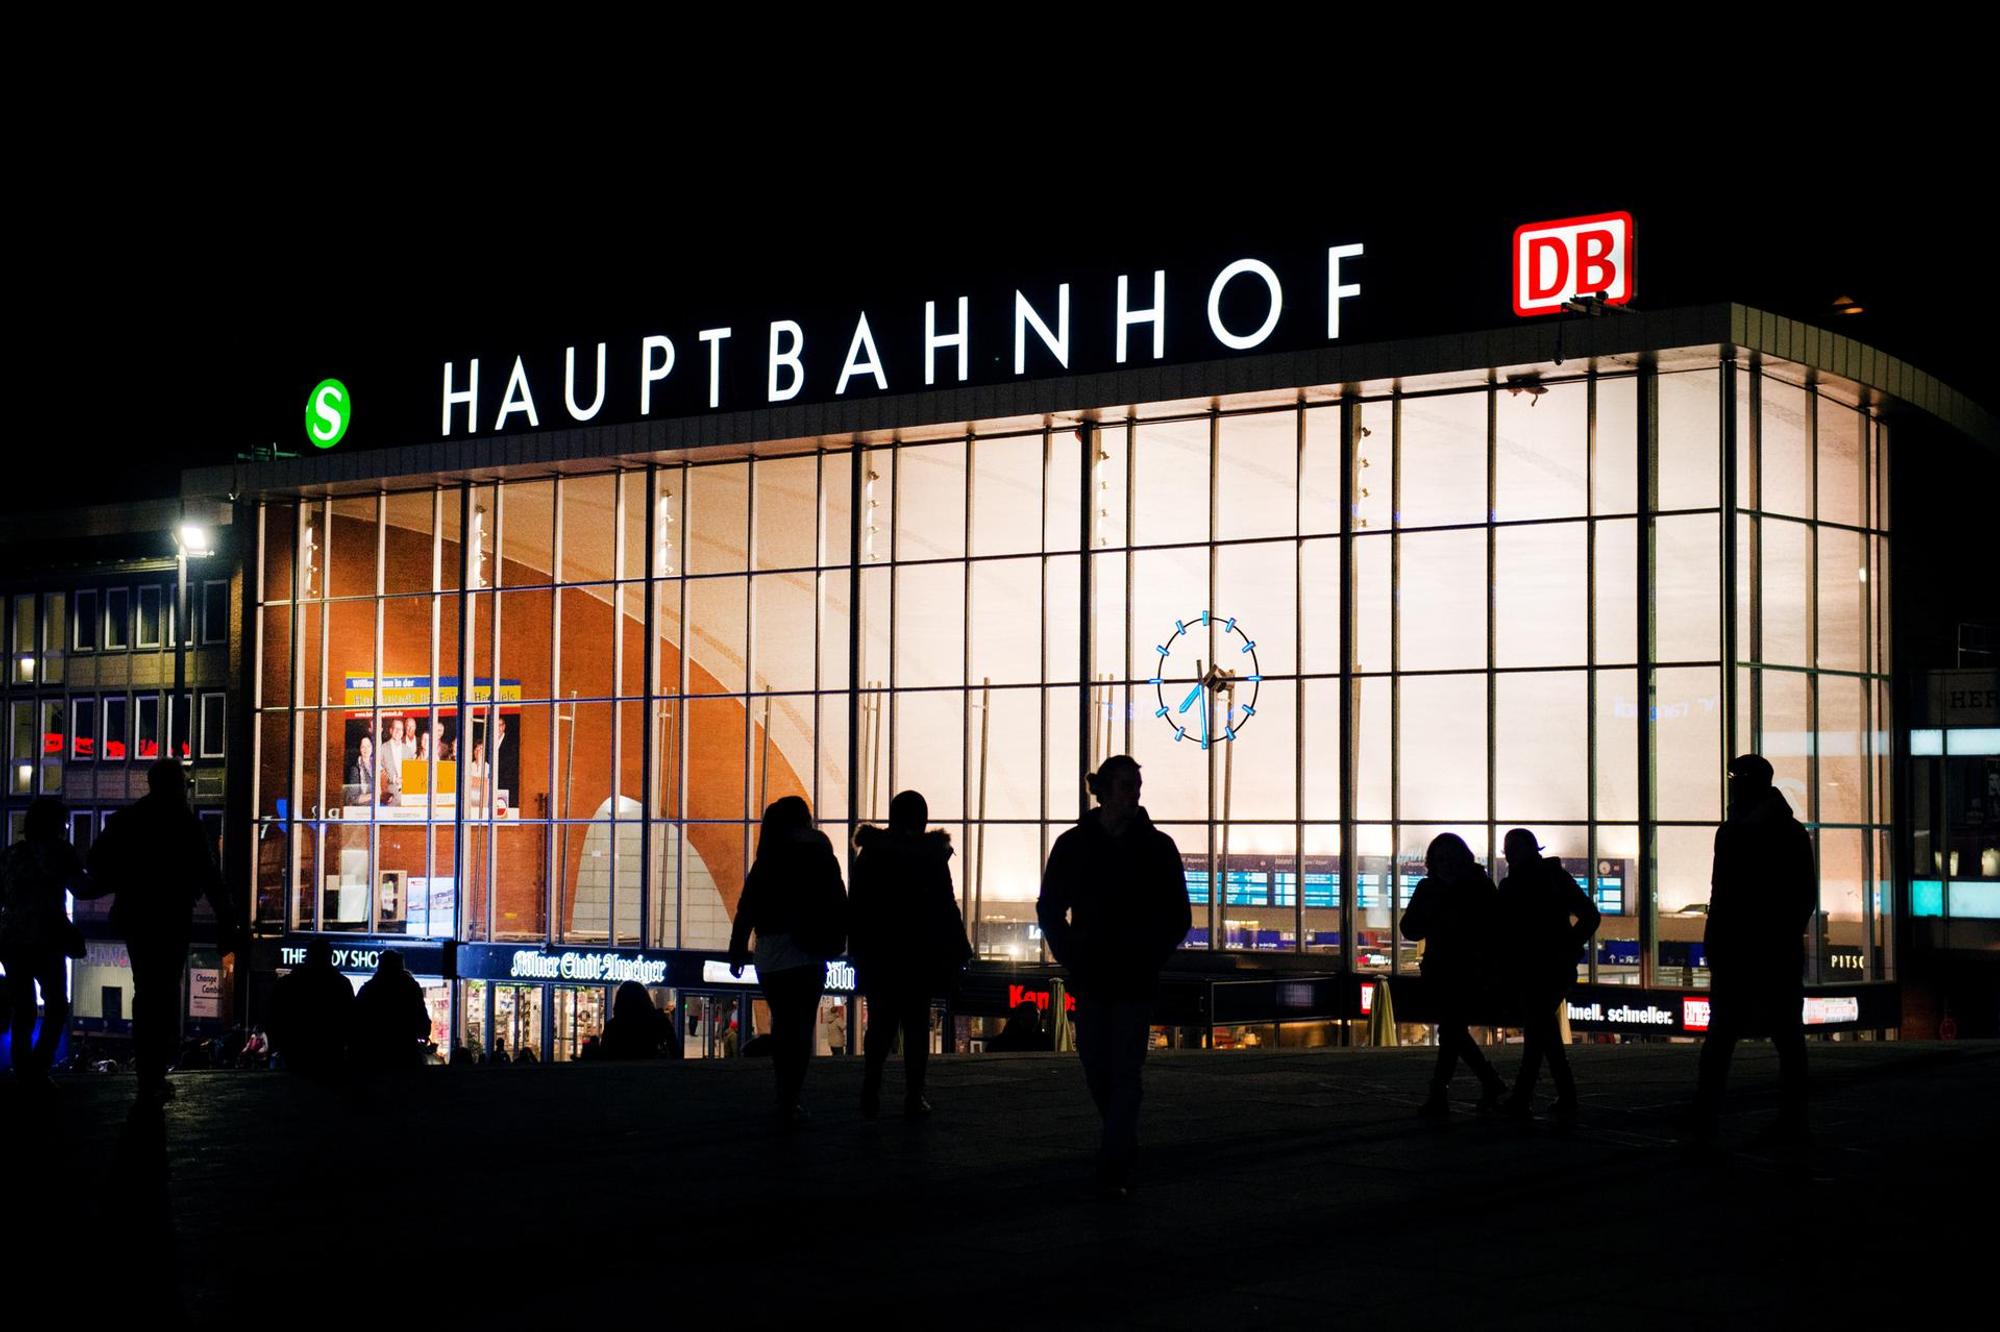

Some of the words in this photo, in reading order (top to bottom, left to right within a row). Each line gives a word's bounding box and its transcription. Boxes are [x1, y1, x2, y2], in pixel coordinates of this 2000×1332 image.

[1528, 229, 1617, 301] DB
[441, 243, 1365, 436] HAUPTBAHNHOF
[313, 386, 342, 441] S
[281, 948, 307, 964] THE
[350, 951, 380, 968] SHO
[1607, 1005, 1674, 1025] schneller.
